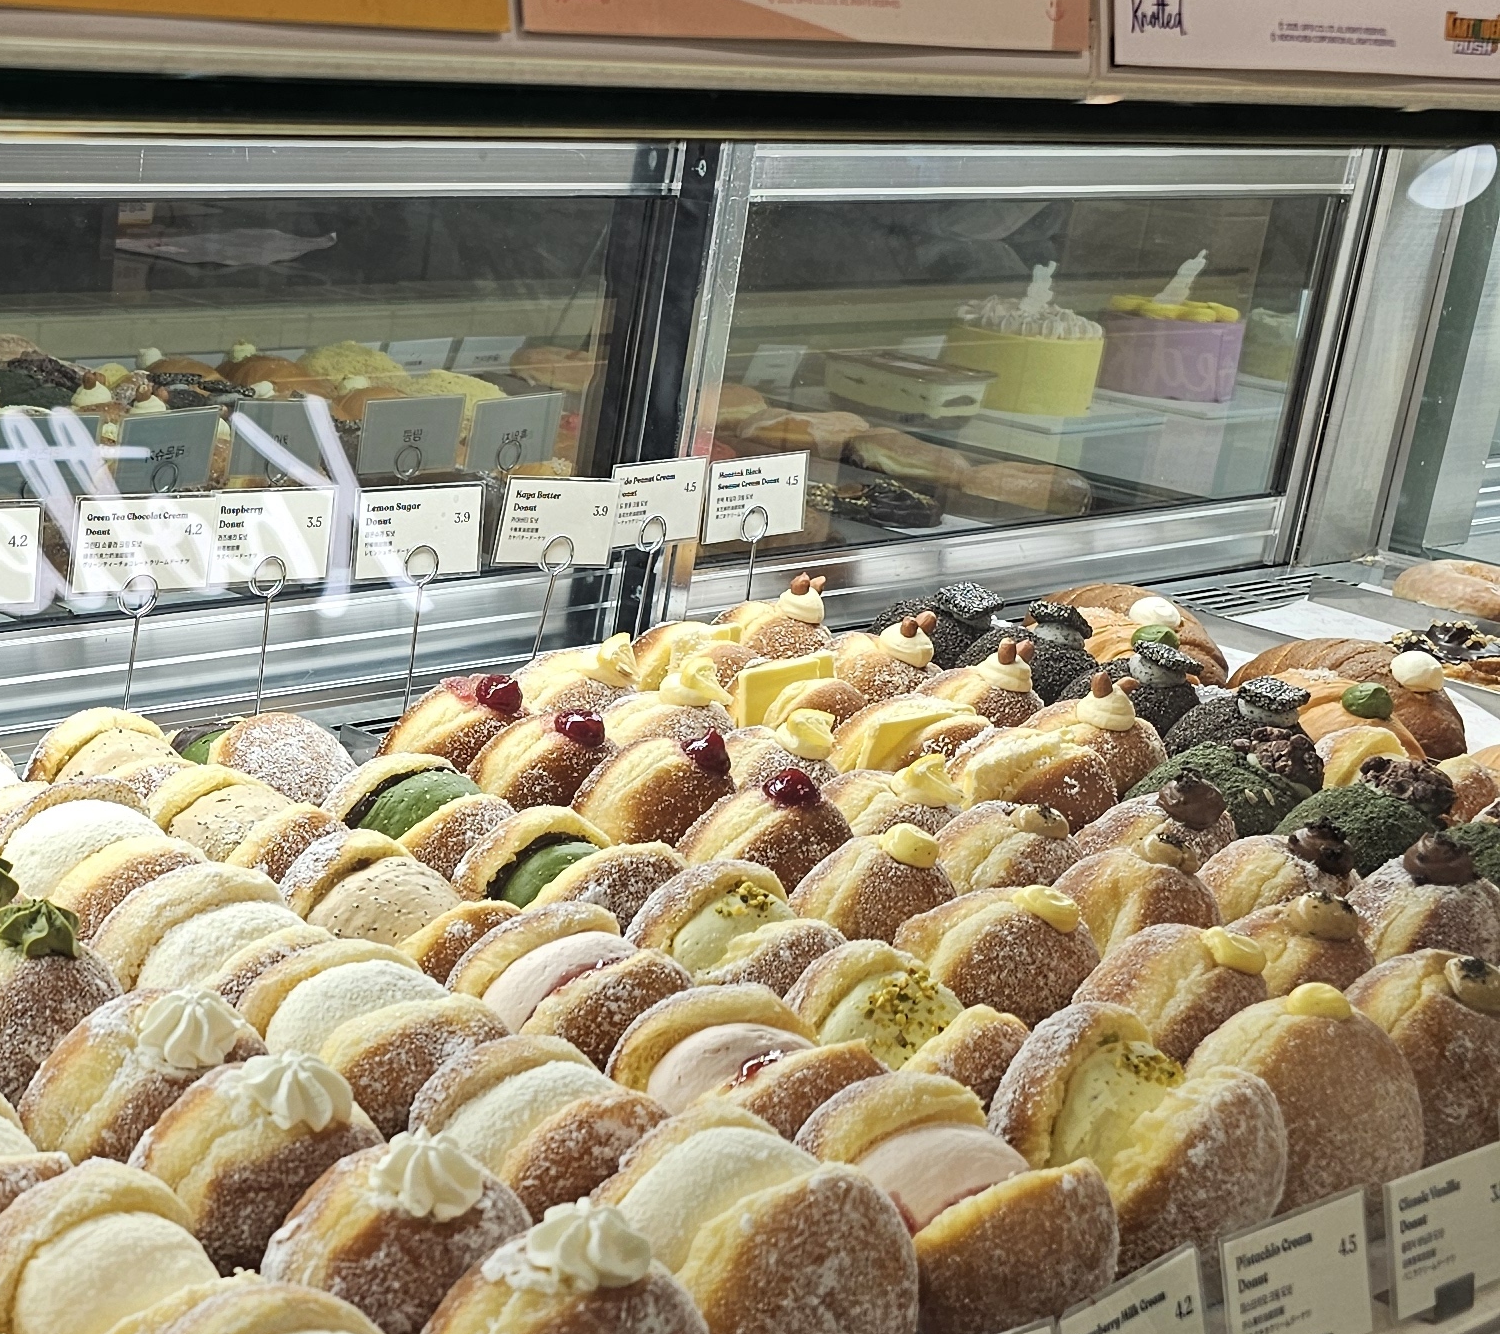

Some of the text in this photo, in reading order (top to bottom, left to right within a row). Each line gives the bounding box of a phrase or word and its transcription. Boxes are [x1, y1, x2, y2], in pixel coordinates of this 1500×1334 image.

[655, 473, 676, 482] Cream
[785, 475, 799, 486] 4.5
[684, 481, 697, 493] 4.5
[515, 490, 562, 501] Kaya Butter
[220, 505, 263, 516] Raspberry
[366, 502, 421, 513] Lemon Sugar
[513, 503, 537, 512] Donut
[592, 505, 609, 517] 3.9
[86, 511, 189, 522] Green Tea Chocolat Cream
[306, 516, 323, 528] 3.5
[365, 517, 392, 526] Donut
[453, 512, 471, 524] 3.9
[184, 524, 203, 536] 4.2
[218, 519, 245, 529] Donut
[85, 528, 111, 537] Donut
[8, 534, 28, 548] 4.2
[1337, 1233, 1358, 1258] 4.5
[1235, 1240, 1282, 1271] Pistachio
[1237, 1271, 1269, 1294] Donut
[1139, 1290, 1167, 1312] Cream
[1175, 1294, 1194, 1321] 4.2
